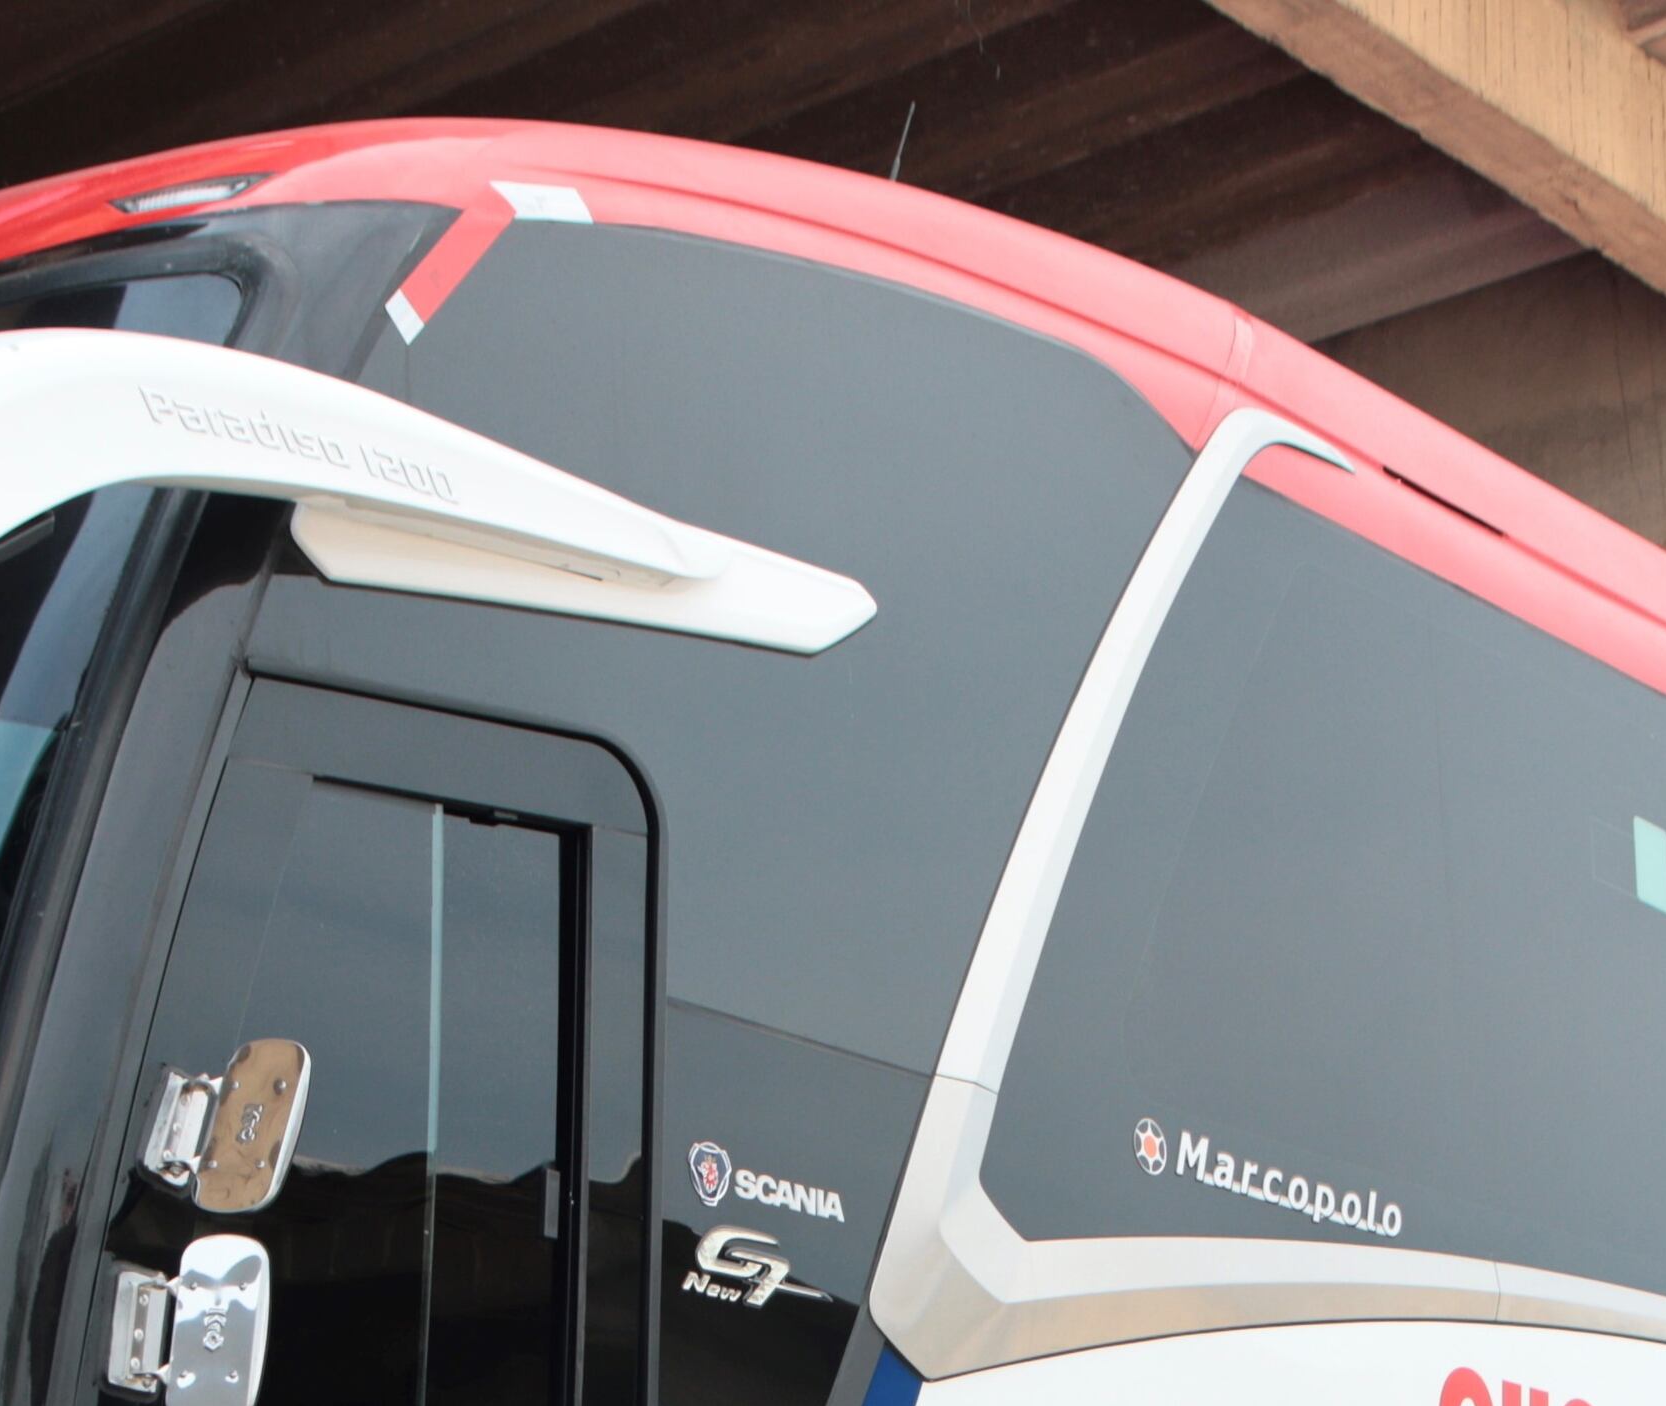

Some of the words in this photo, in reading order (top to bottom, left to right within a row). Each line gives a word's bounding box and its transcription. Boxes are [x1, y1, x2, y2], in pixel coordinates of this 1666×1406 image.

[138, 386, 352, 469] Paradiso
[359, 445, 460, 504] 1200
[735, 1169, 845, 1223] SCANIA
[1175, 1130, 1403, 1238] Marcopolo
[682, 1271, 743, 1303] New
